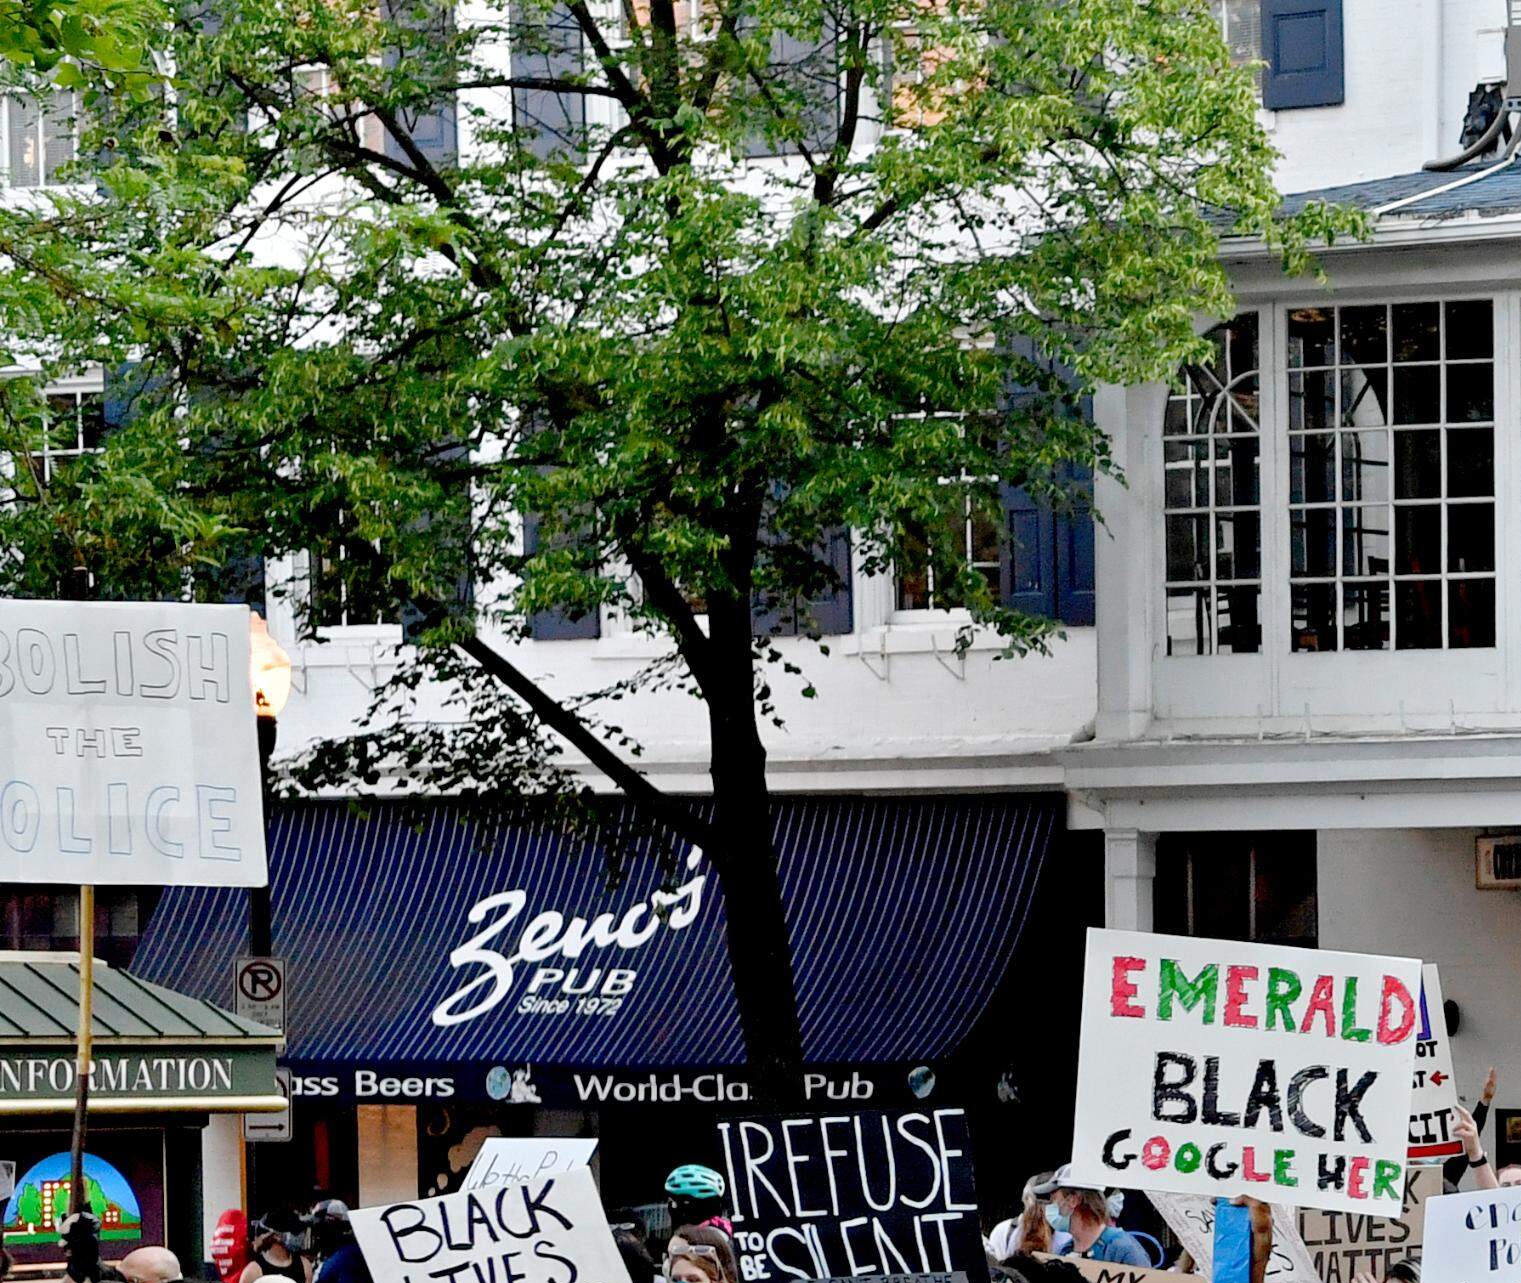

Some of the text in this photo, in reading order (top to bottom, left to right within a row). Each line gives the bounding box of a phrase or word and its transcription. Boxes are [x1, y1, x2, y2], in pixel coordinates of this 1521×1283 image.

[46, 727, 143, 758] THE
[527, 967, 637, 995] PUB
[517, 994, 622, 1015] Since 1972
[1110, 956, 1415, 1045] EMERALD
[355, 1071, 454, 1097] Beers
[1151, 1050, 1379, 1144] BLACK
[717, 1108, 978, 1222] I REFUSE
[1101, 1129, 1401, 1200] GOOGLE HER
[381, 1178, 573, 1263] BLACK
[1301, 1210, 1411, 1246] LIVES
[734, 1231, 765, 1252] TO
[739, 1254, 771, 1281] BE
